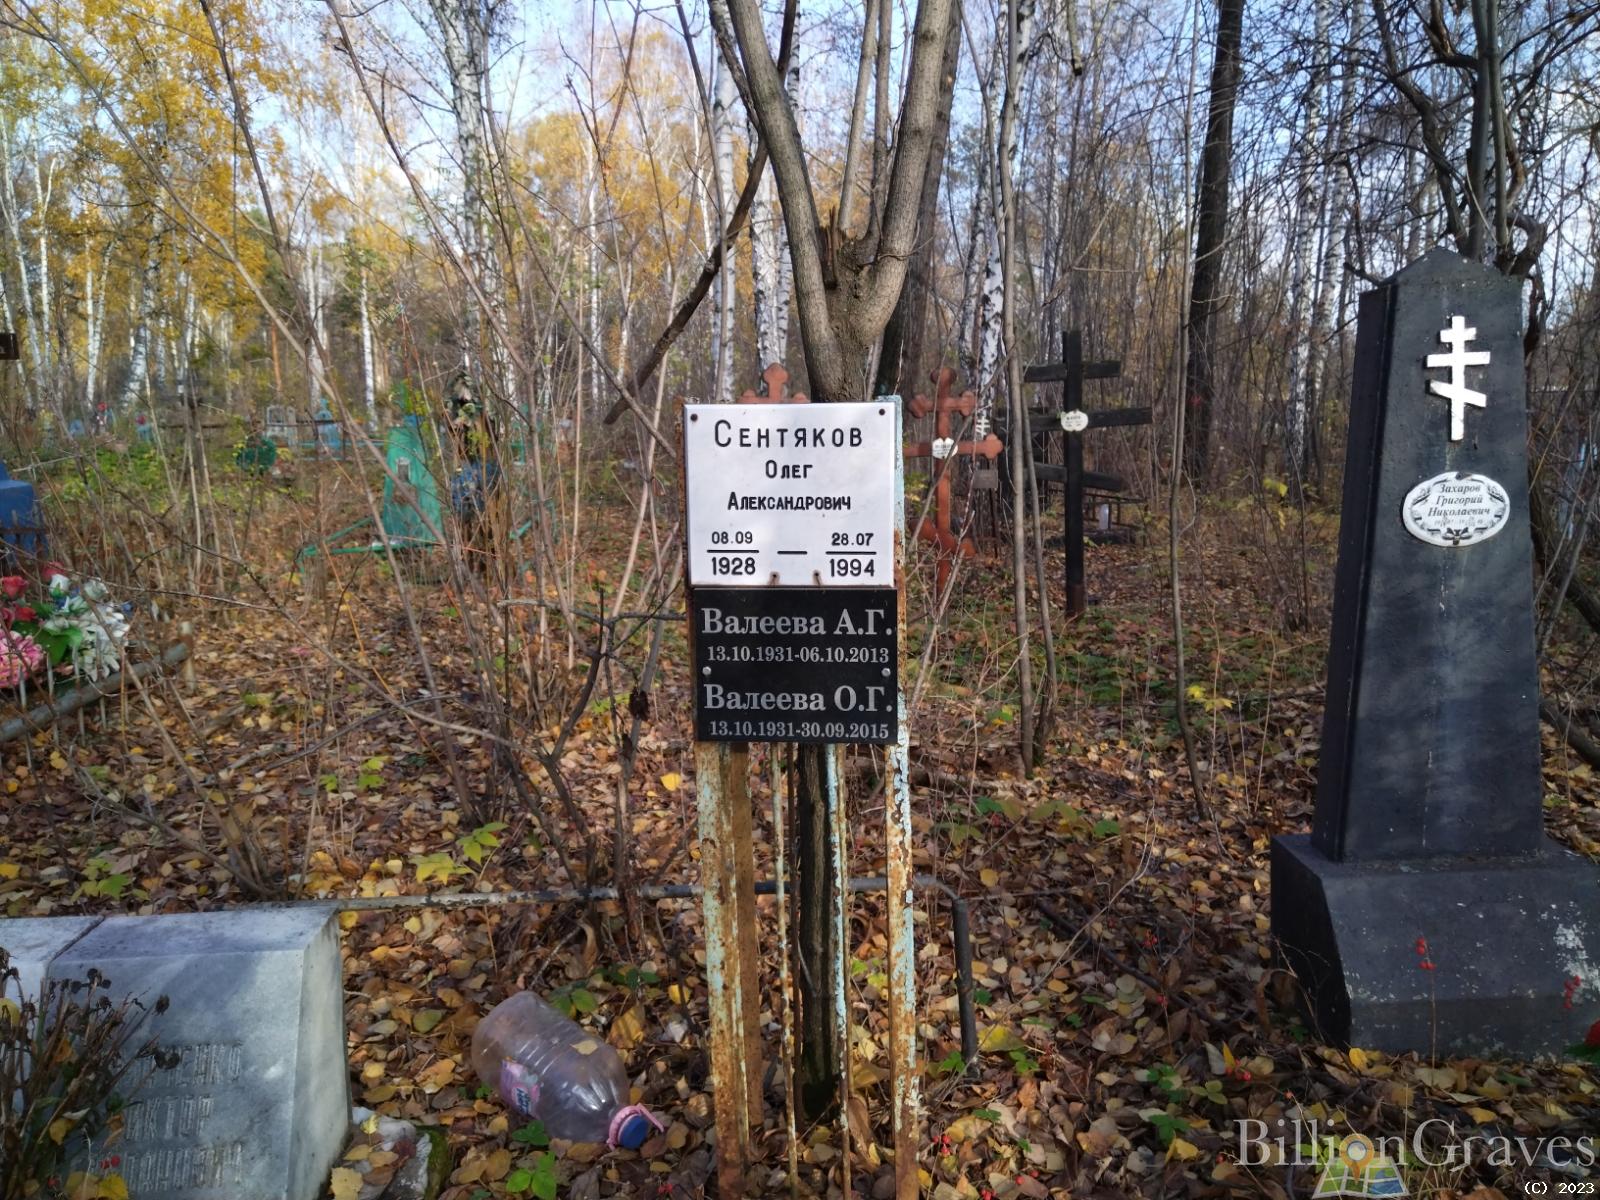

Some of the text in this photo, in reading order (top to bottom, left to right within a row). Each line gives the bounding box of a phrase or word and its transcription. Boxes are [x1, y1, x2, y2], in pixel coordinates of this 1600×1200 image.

[714, 420, 863, 448] СЕНТЯКОВ
[765, 459, 813, 479] ОЛЕГ
[1439, 483, 1480, 494] Захаров
[727, 491, 851, 511] АЛЕКСАНДРОВИЧ
[1435, 494, 1483, 506] Григорий
[1427, 507, 1490, 518] Николаевич
[711, 531, 874, 546] 08.09 28.07
[711, 556, 875, 577] 1928 1994
[701, 608, 893, 636] Валеева А.Г.
[707, 646, 889, 664] 13.10.1931-06.10.2013
[703, 683, 893, 712] Валеева О.Г.
[709, 720, 889, 739] 13.10.1931-30.09.2015
